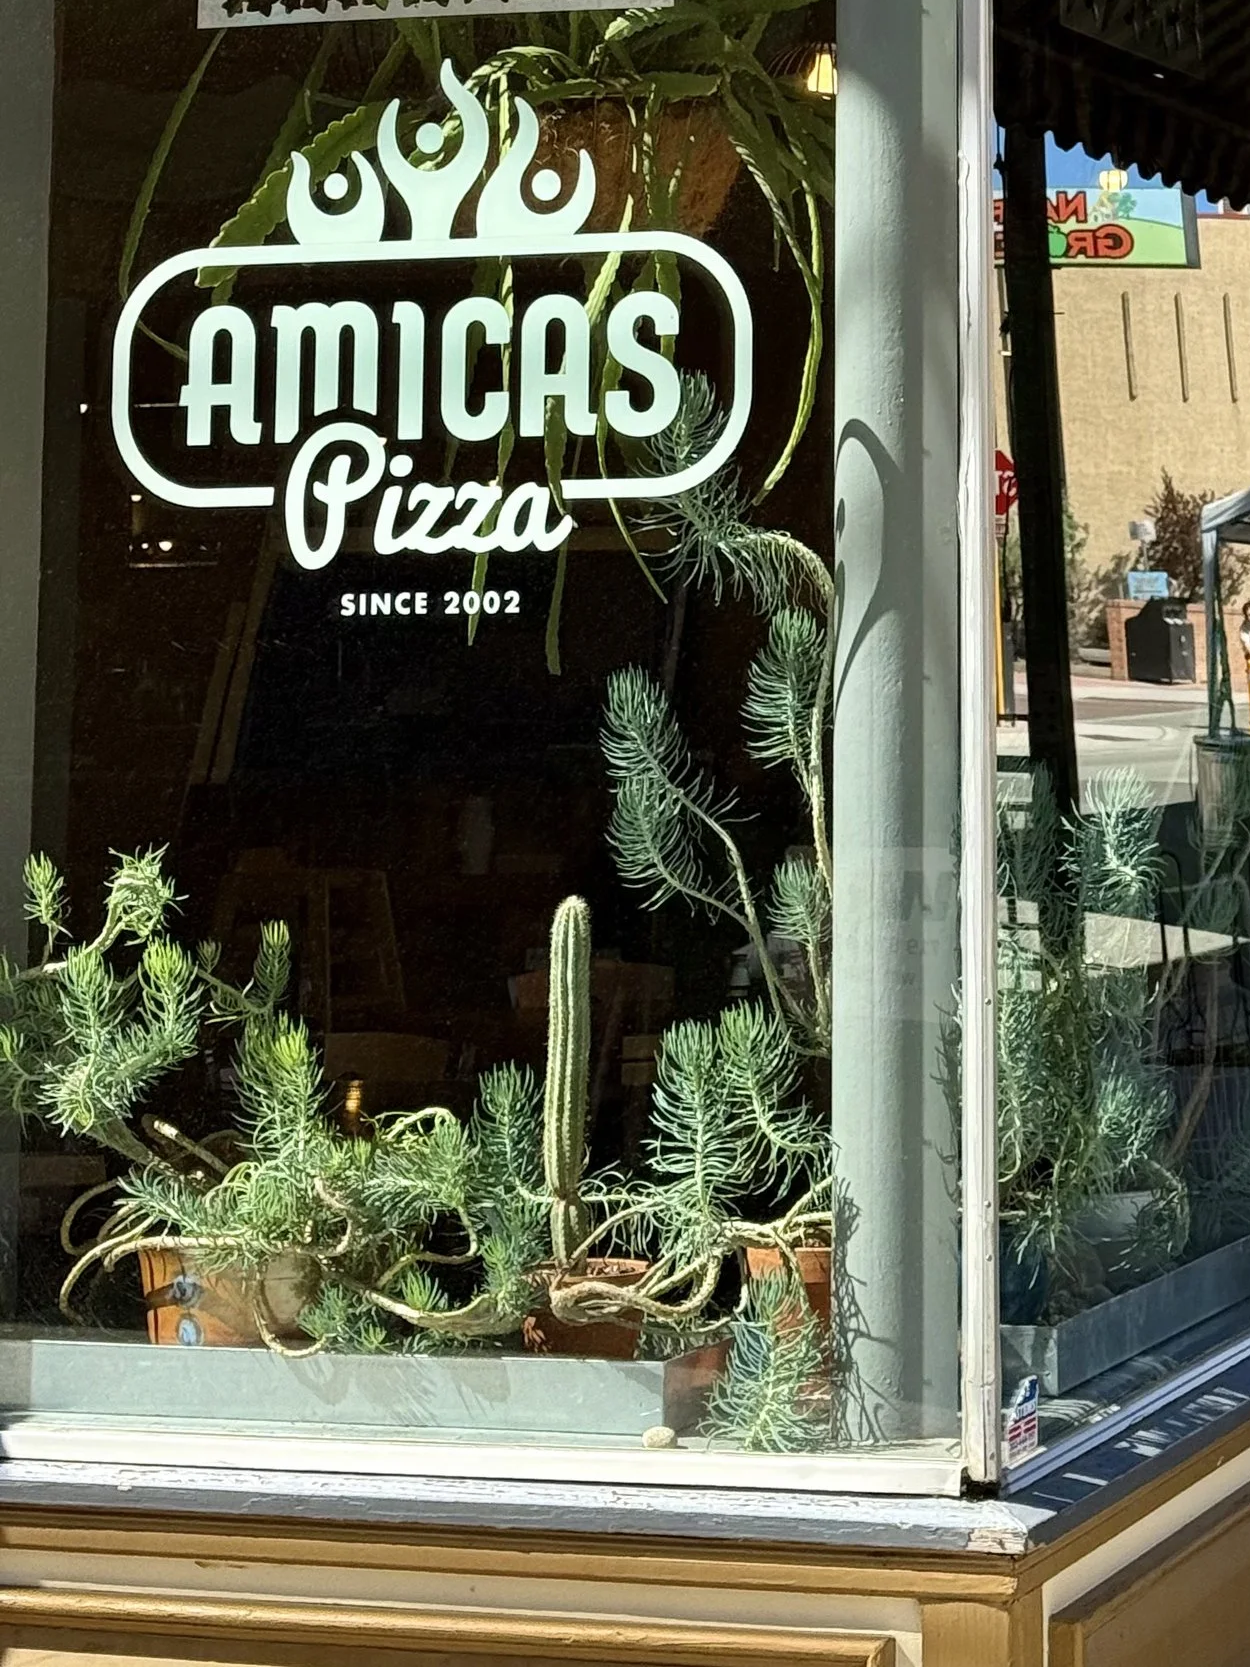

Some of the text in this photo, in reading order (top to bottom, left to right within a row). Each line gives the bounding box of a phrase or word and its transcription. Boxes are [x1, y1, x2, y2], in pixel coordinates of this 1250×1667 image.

[179, 290, 681, 446] AMICAS
[285, 422, 577, 571] Pizza
[339, 590, 521, 617] SINCE 2002
